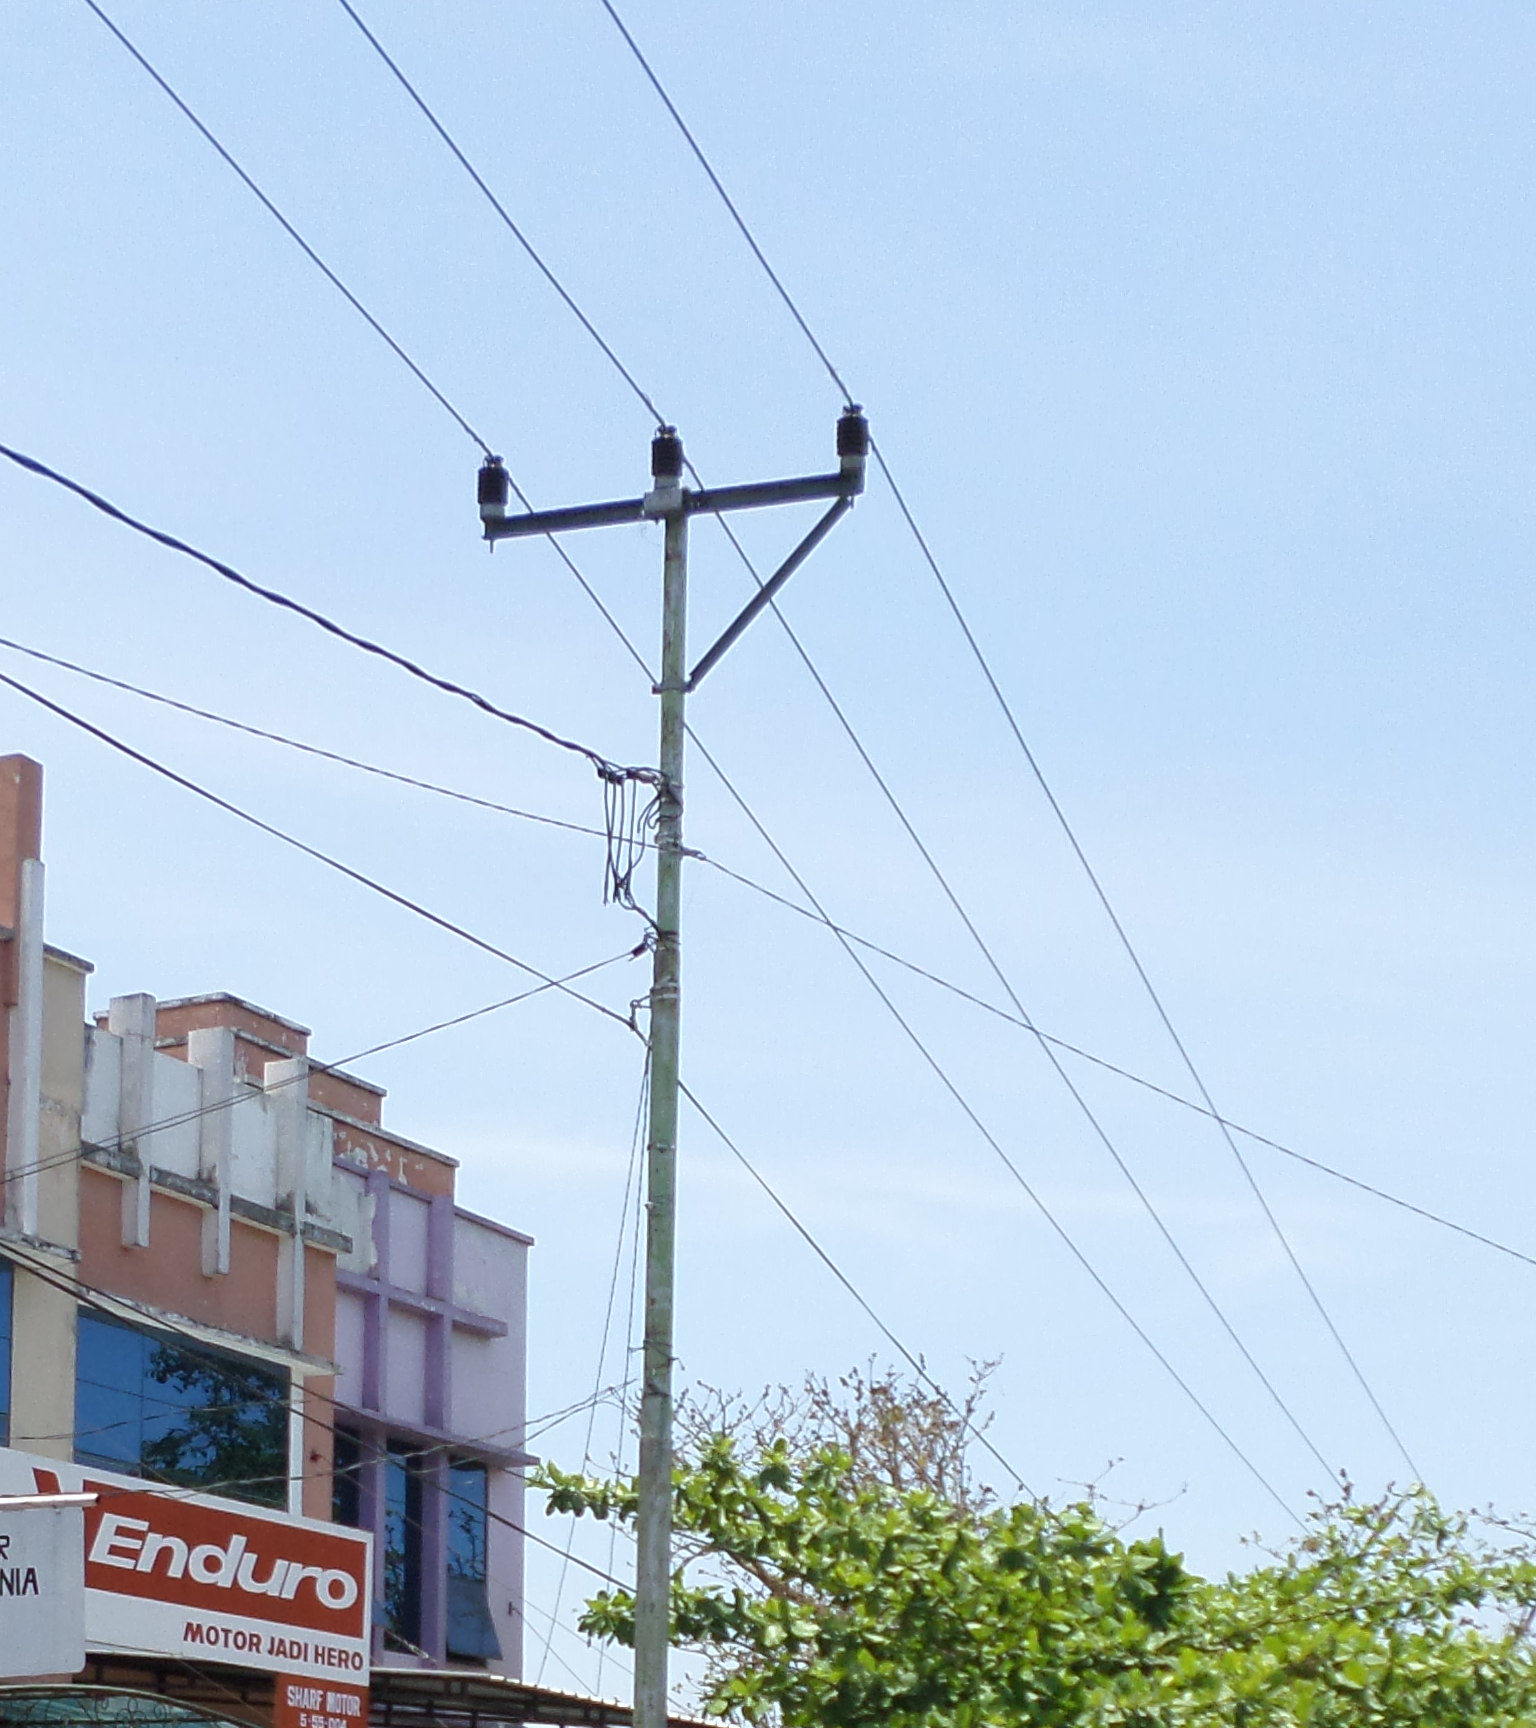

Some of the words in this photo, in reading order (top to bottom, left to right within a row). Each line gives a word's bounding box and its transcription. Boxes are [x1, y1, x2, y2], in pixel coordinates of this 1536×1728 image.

[88, 1512, 359, 1610] Enduro
[183, 1621, 263, 1654] MOTOR
[267, 1636, 309, 1662] JADI
[314, 1644, 364, 1671] HERO
[326, 1691, 361, 1717] MOTOR
